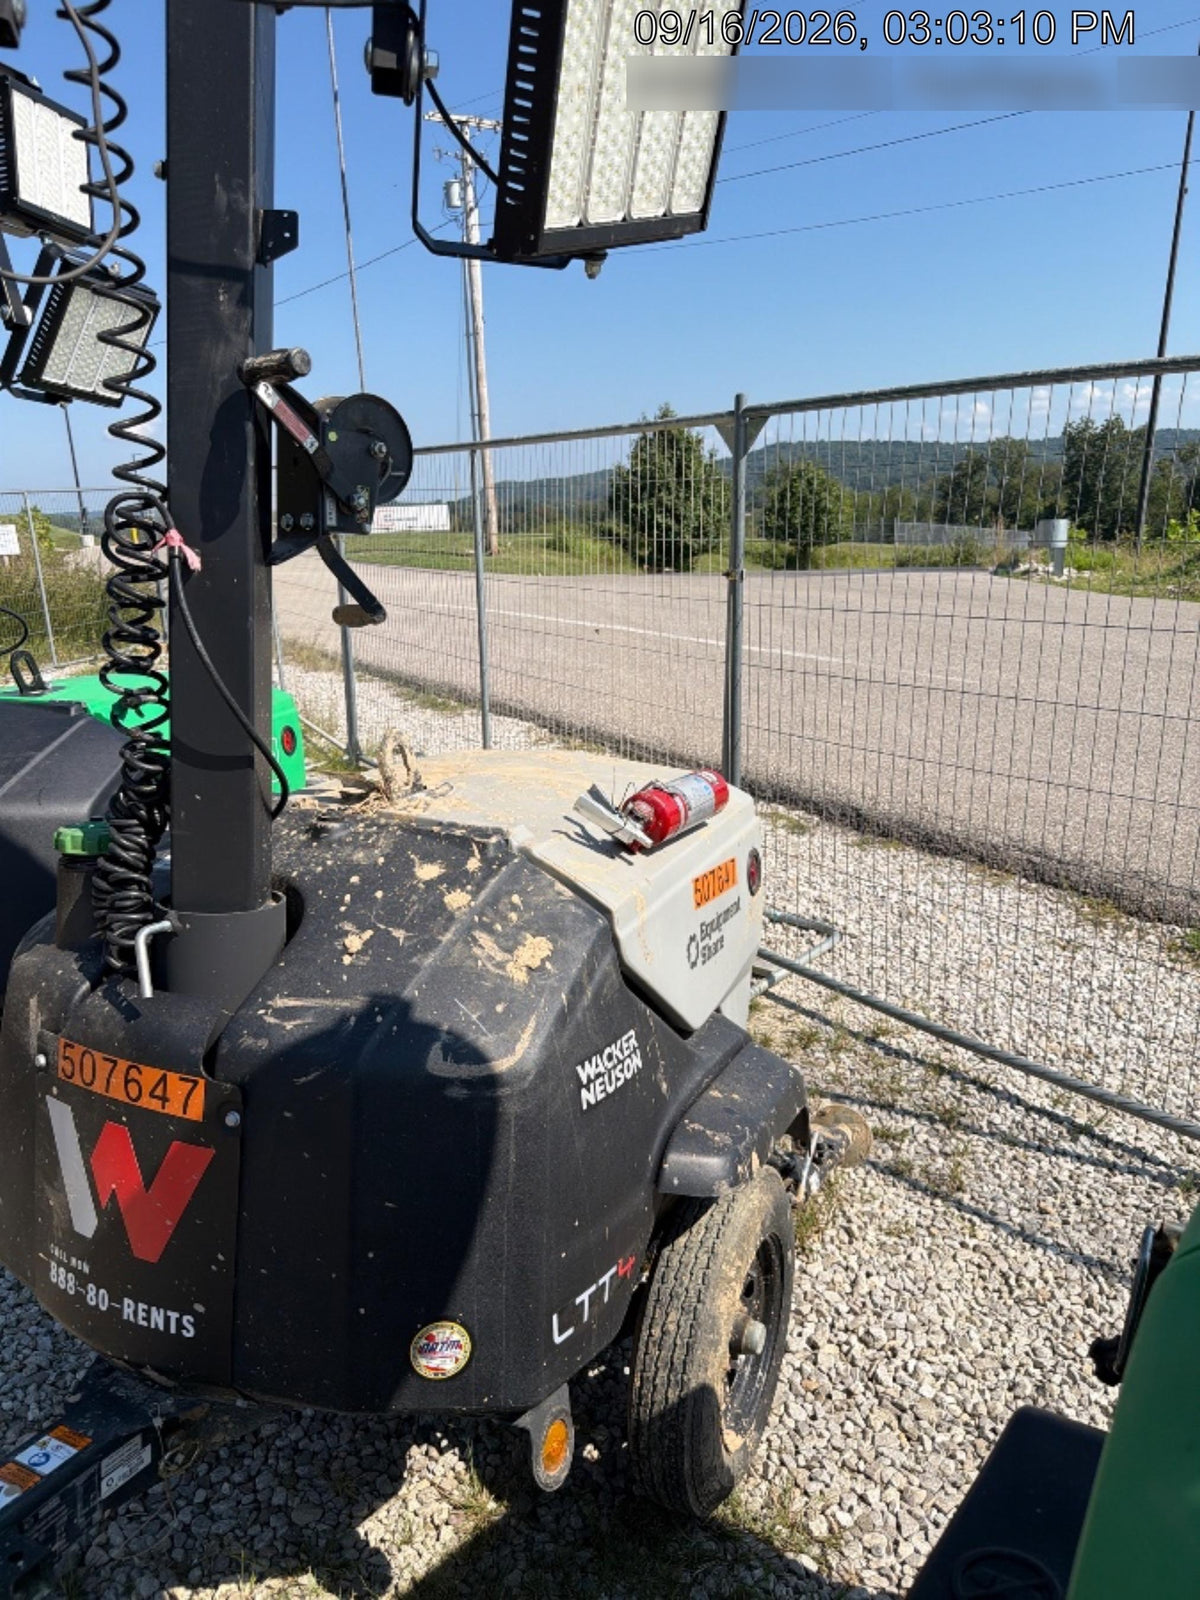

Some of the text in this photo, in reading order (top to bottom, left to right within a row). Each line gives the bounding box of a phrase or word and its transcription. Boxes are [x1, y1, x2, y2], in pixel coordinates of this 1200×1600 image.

[700, 896, 741, 942] Equipment
[701, 934, 725, 966] Share
[60, 1042, 201, 1115] 507647
[576, 1029, 639, 1085] WACKER
[581, 1049, 642, 1110] NEUSON
[552, 1255, 636, 1345] LTT4
